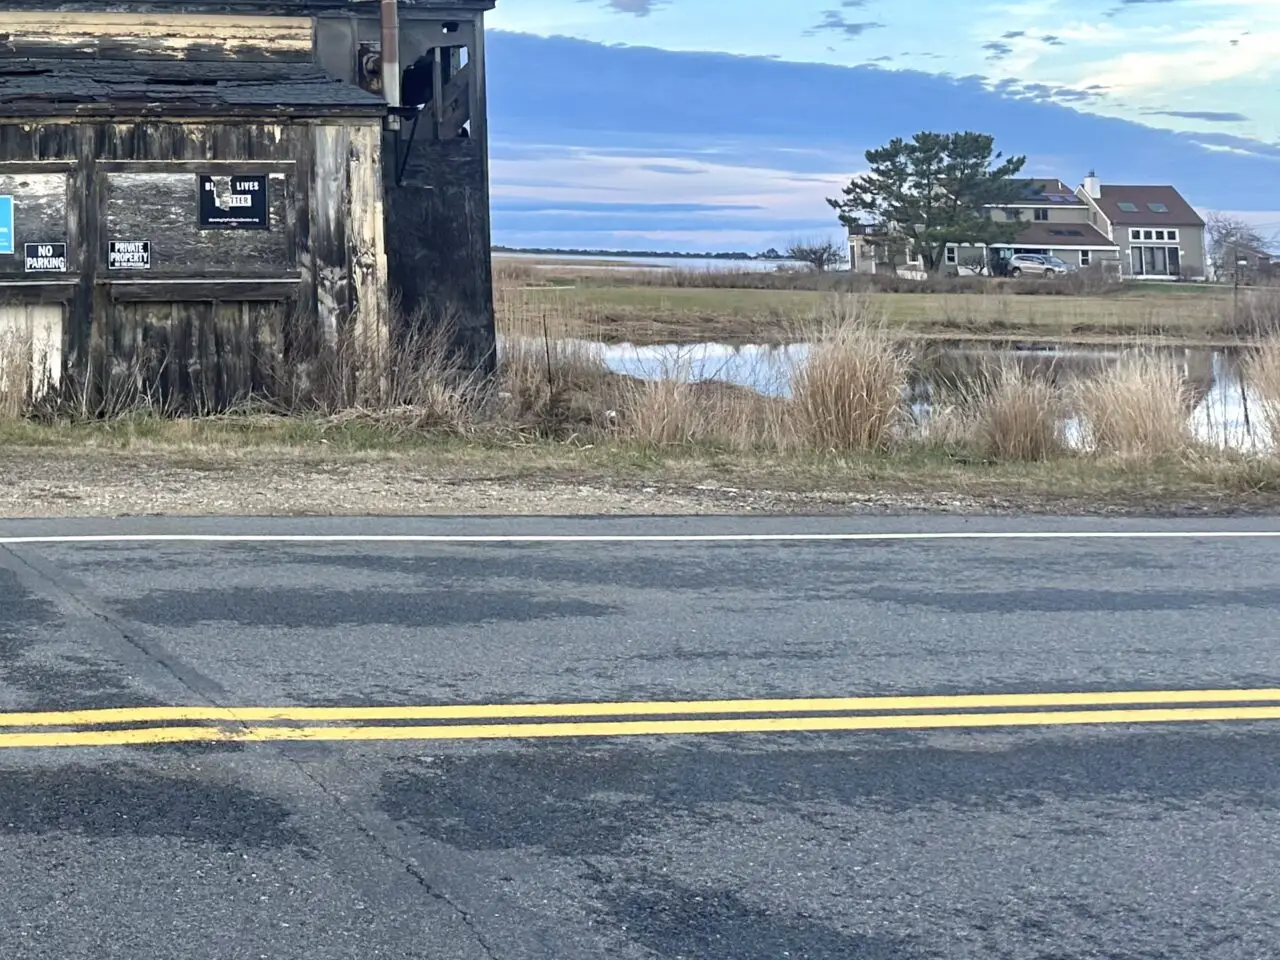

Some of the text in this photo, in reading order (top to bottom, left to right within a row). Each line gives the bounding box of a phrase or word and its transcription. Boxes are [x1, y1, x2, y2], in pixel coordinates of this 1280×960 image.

[236, 181, 259, 191] LIVES
[37, 245, 53, 257] NO
[115, 242, 144, 253] PRIVATE
[110, 252, 148, 262] PROPERTY
[26, 257, 65, 269] PARKING
